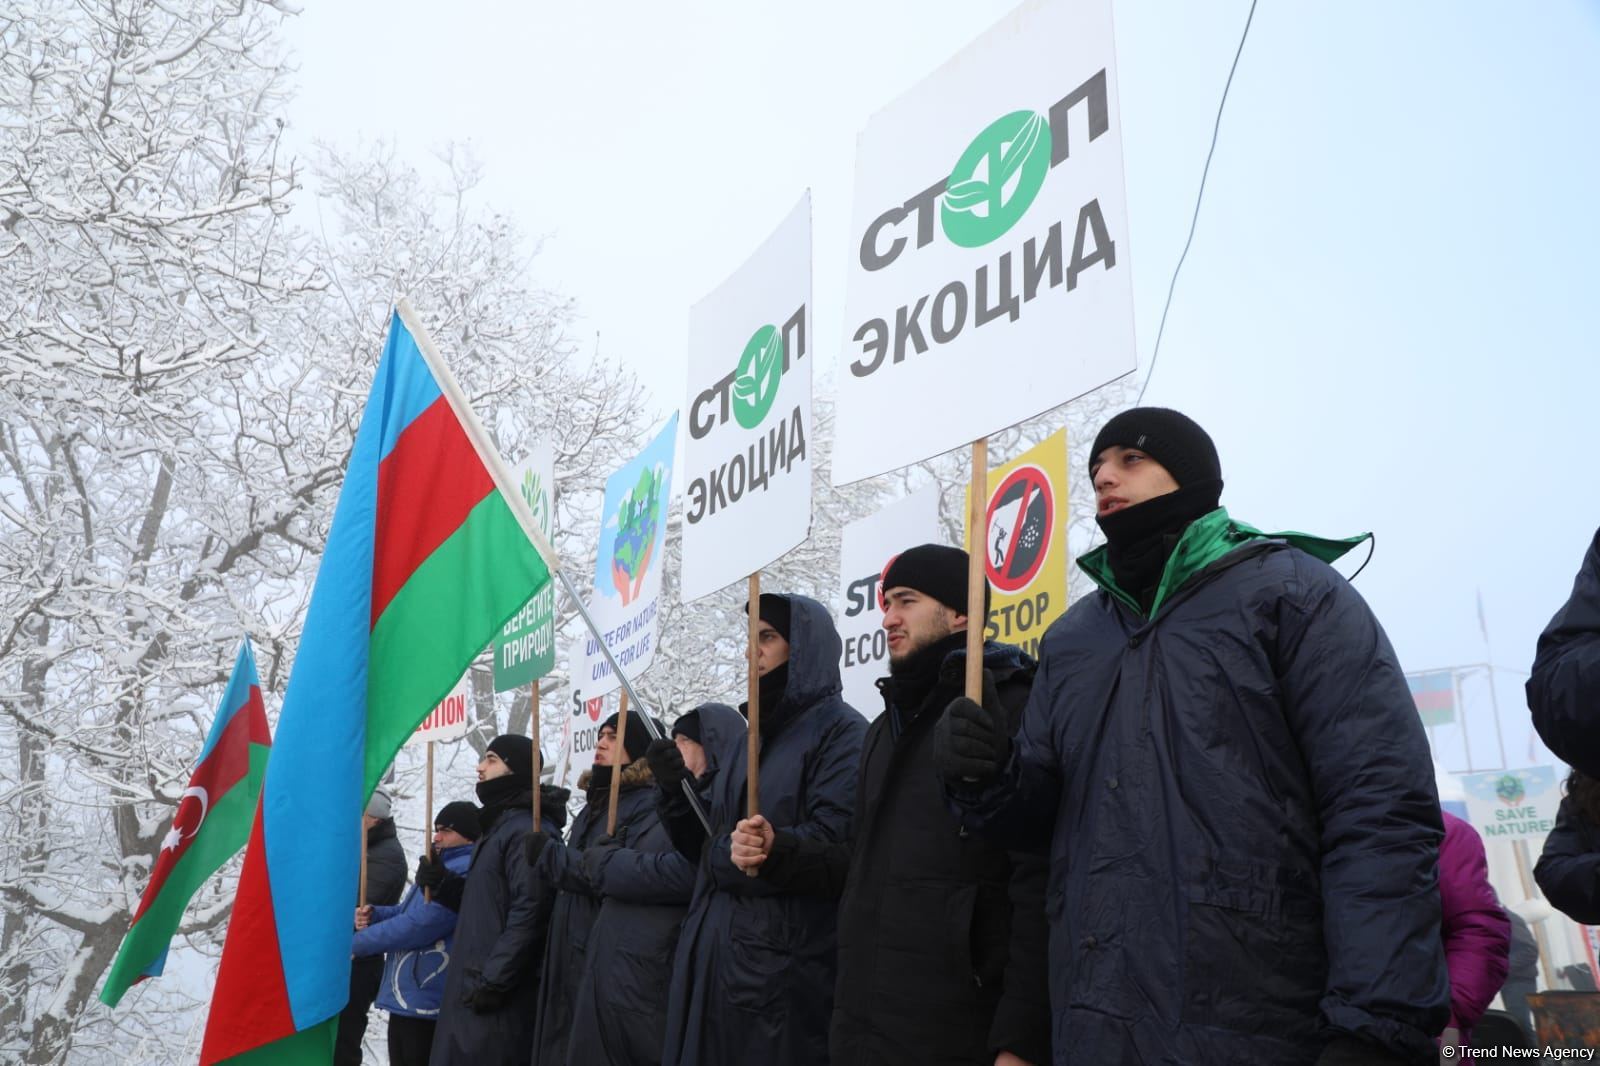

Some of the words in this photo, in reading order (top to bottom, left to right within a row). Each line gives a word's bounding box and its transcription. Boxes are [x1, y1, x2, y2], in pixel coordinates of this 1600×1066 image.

[859, 67, 1109, 272] СТОП
[850, 198, 1116, 378] ЭКОЦИД
[689, 303, 806, 440] СТОП
[687, 405, 806, 524] ЭКОЦИД
[845, 572, 884, 617] ST
[985, 591, 1049, 642] STOP
[586, 630, 615, 656] UNTE
[615, 620, 632, 644] FOR
[632, 596, 658, 634] NATURE
[619, 644, 635, 668] FOR
[635, 632, 651, 659] LIFE
[844, 628, 887, 668] ECO
[416, 694, 465, 732] UTION
[574, 725, 600, 753] ECOC
[1495, 806, 1537, 821] SAVE
